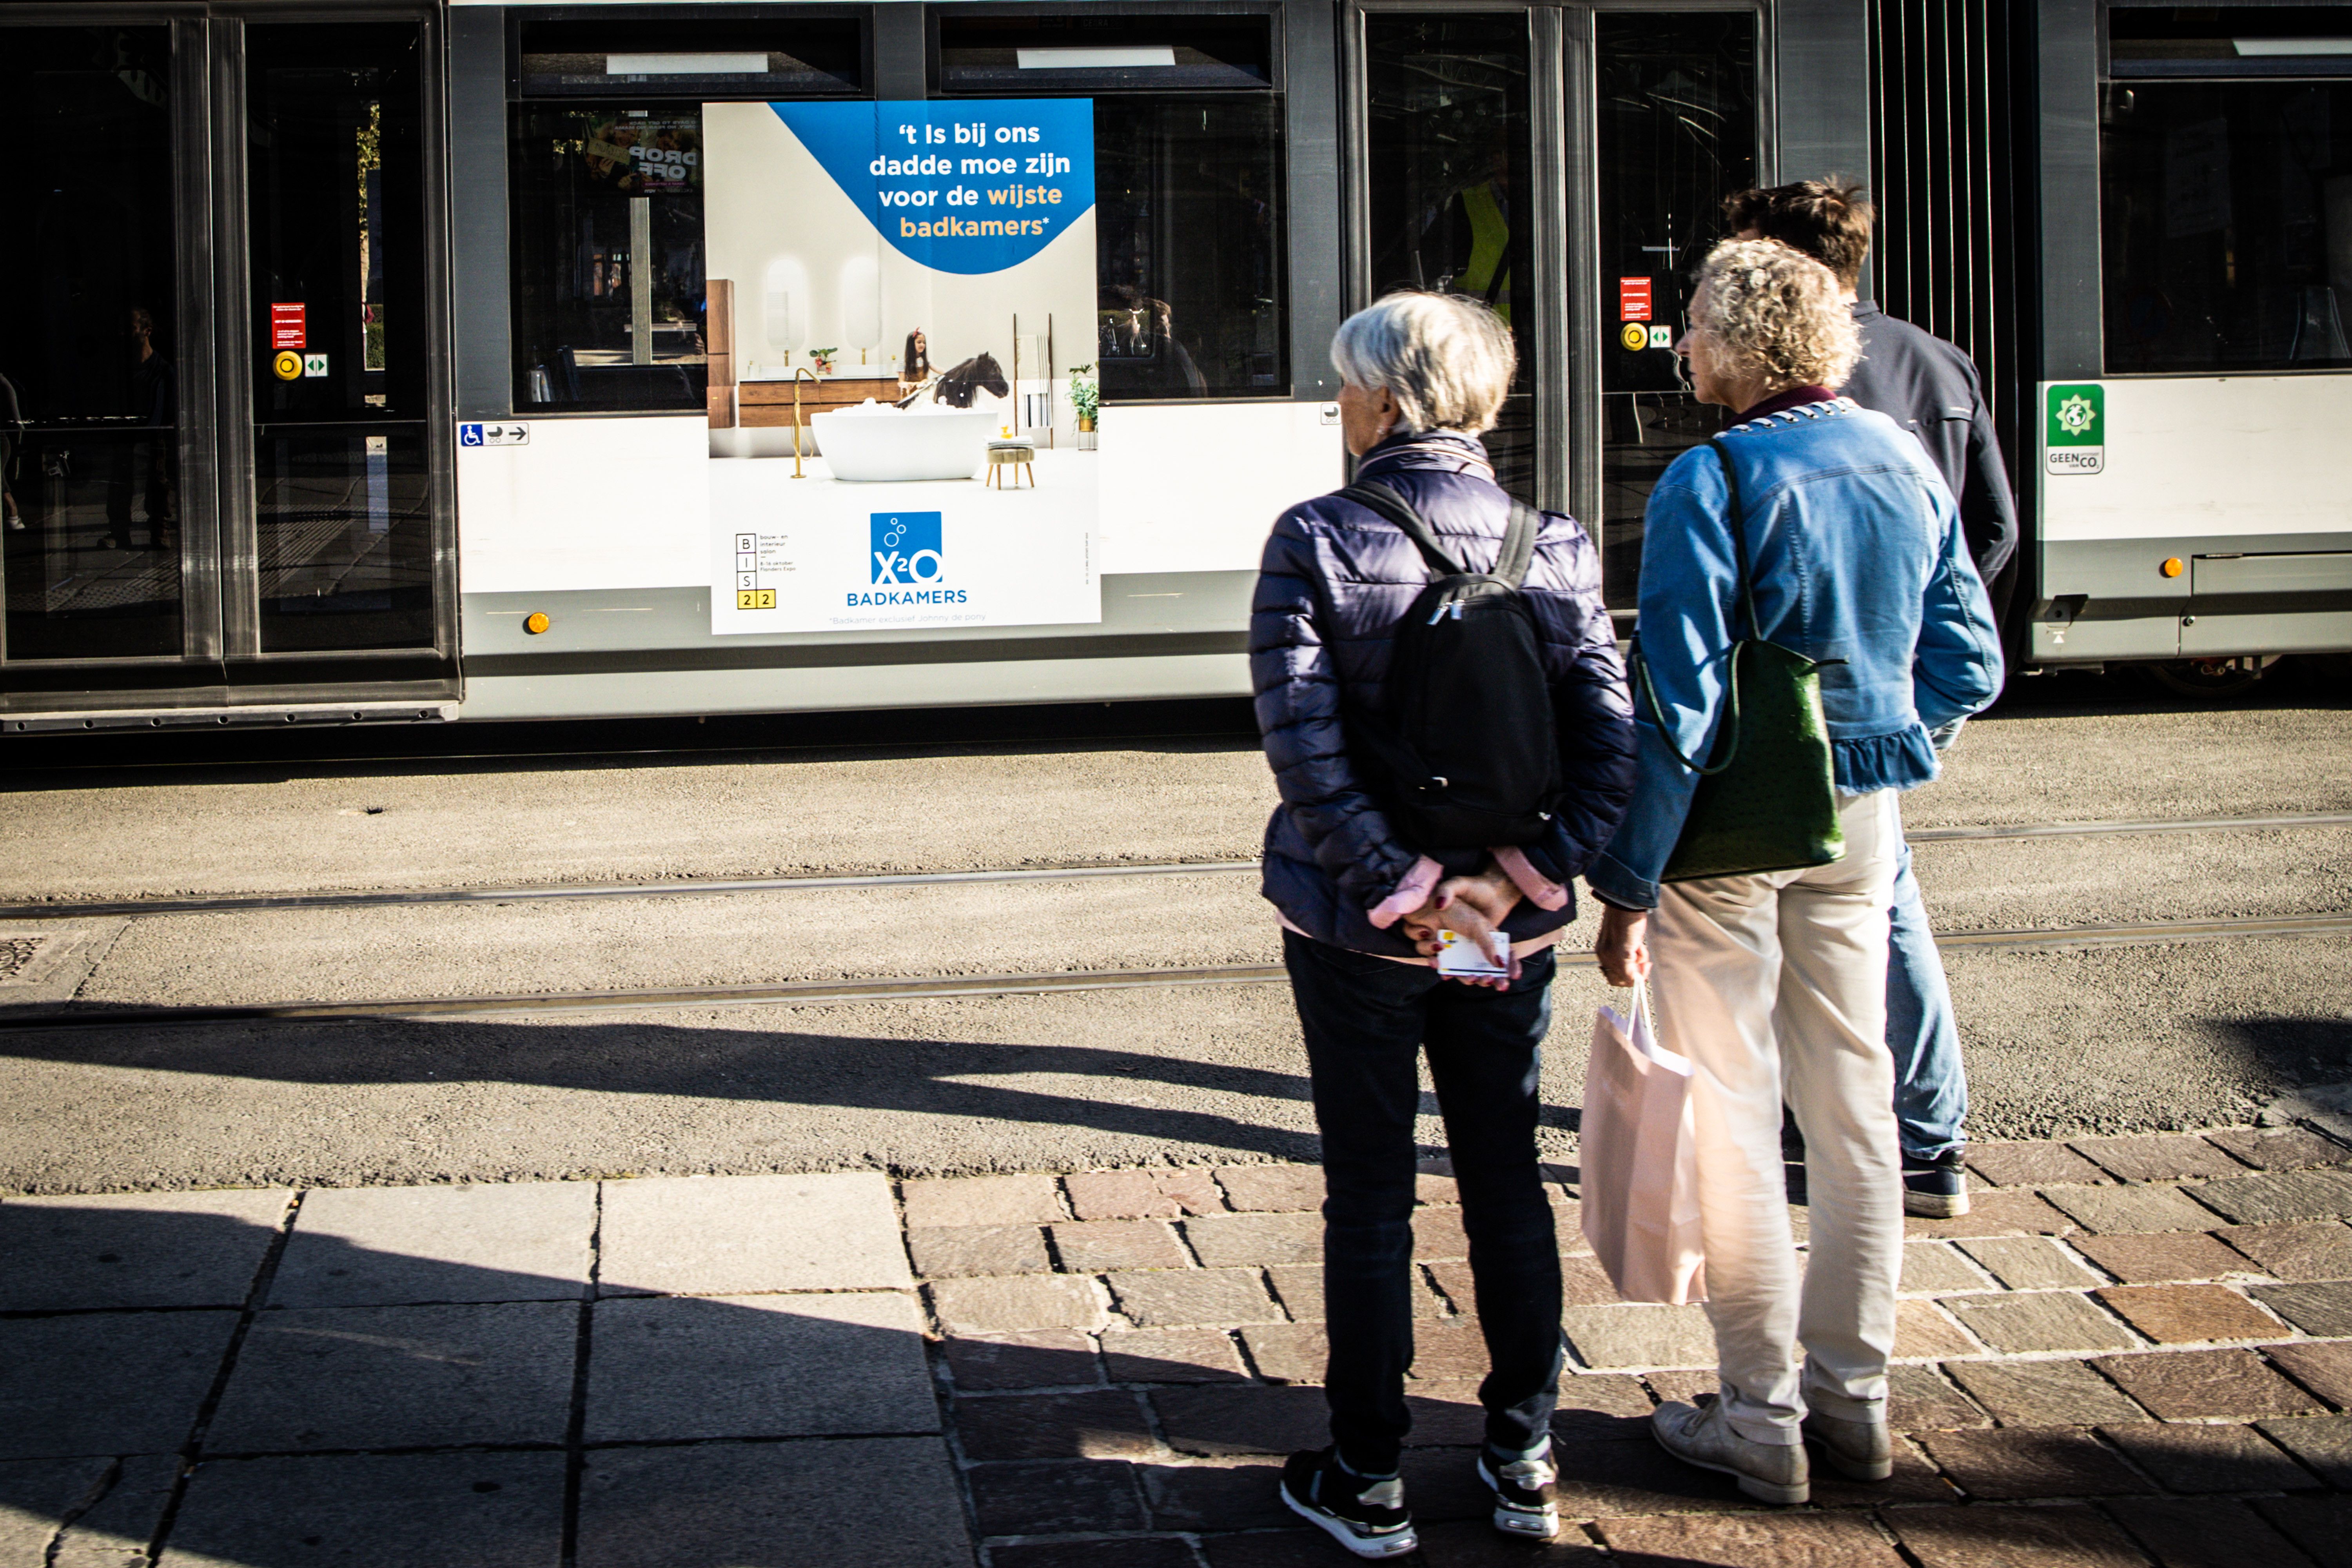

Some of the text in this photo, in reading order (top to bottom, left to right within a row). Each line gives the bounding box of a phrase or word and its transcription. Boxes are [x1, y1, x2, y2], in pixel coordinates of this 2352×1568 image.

[926, 124, 946, 143] Is
[955, 123, 985, 147] bij
[995, 126, 1040, 143] ons
[869, 153, 1070, 177] dadde moe zijn
[878, 185, 1062, 208] voor de wijste
[2050, 454, 2079, 463] GEEN
[847, 590, 967, 606] BADKAMERS
[879, 615, 915, 623] exclusief
